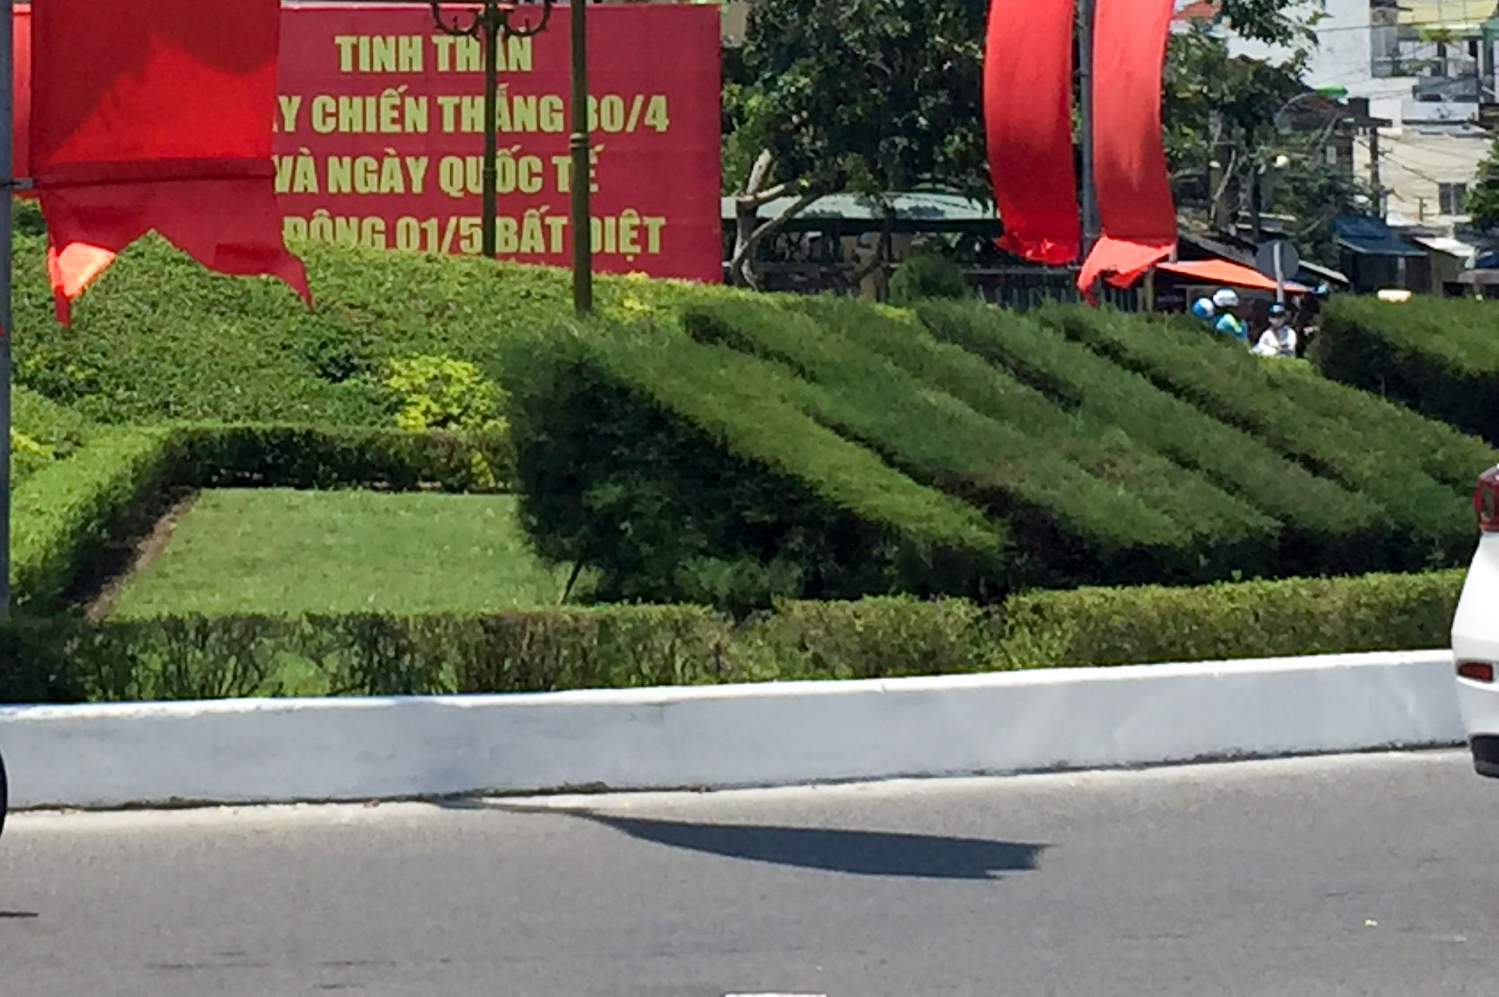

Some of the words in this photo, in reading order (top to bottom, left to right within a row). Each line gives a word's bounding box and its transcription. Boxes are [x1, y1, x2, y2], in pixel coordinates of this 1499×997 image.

[334, 34, 423, 72] TINH
[312, 84, 428, 134] CHIẾN
[327, 147, 429, 194] NGÀY
[395, 215, 483, 254] 01/5
[495, 205, 568, 254] BẤT
